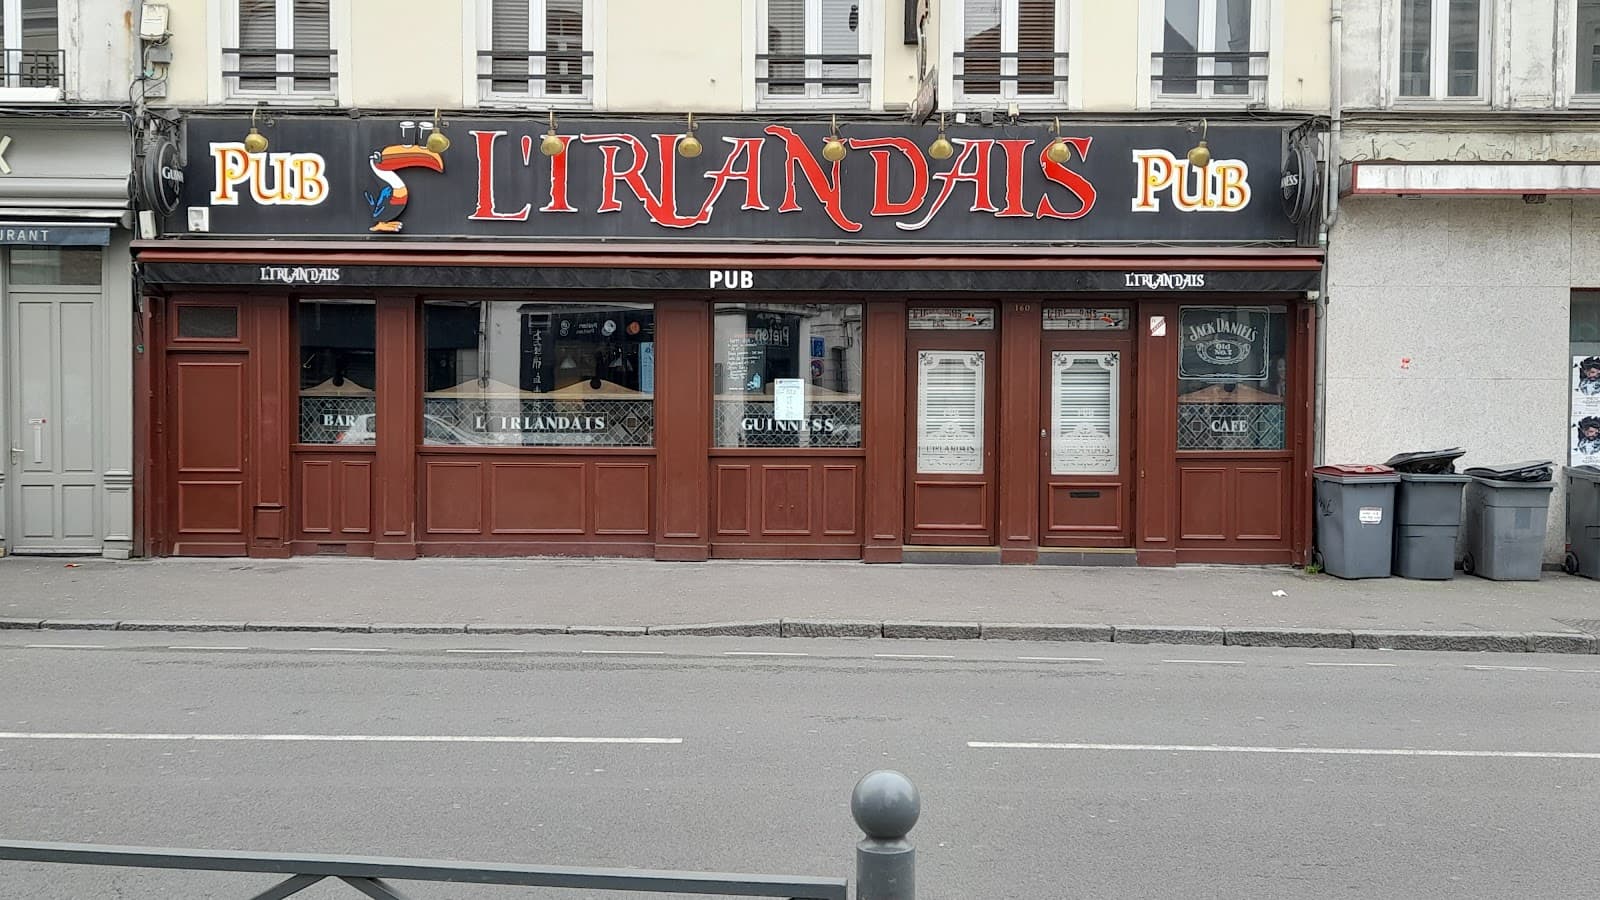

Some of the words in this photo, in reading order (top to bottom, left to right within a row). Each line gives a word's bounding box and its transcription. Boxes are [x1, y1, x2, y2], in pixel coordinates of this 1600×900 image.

[468, 125, 1096, 232] L'IRLANDAIS
[260, 266, 340, 283] L'IRLANDAIS
[709, 271, 753, 288] PUB
[1125, 272, 1205, 289] L'IRLANDAIS
[1190, 322, 1216, 341] JACK
[323, 414, 356, 426] BAR
[741, 417, 834, 432] GUINNESS
[1211, 420, 1249, 432] CAFE
